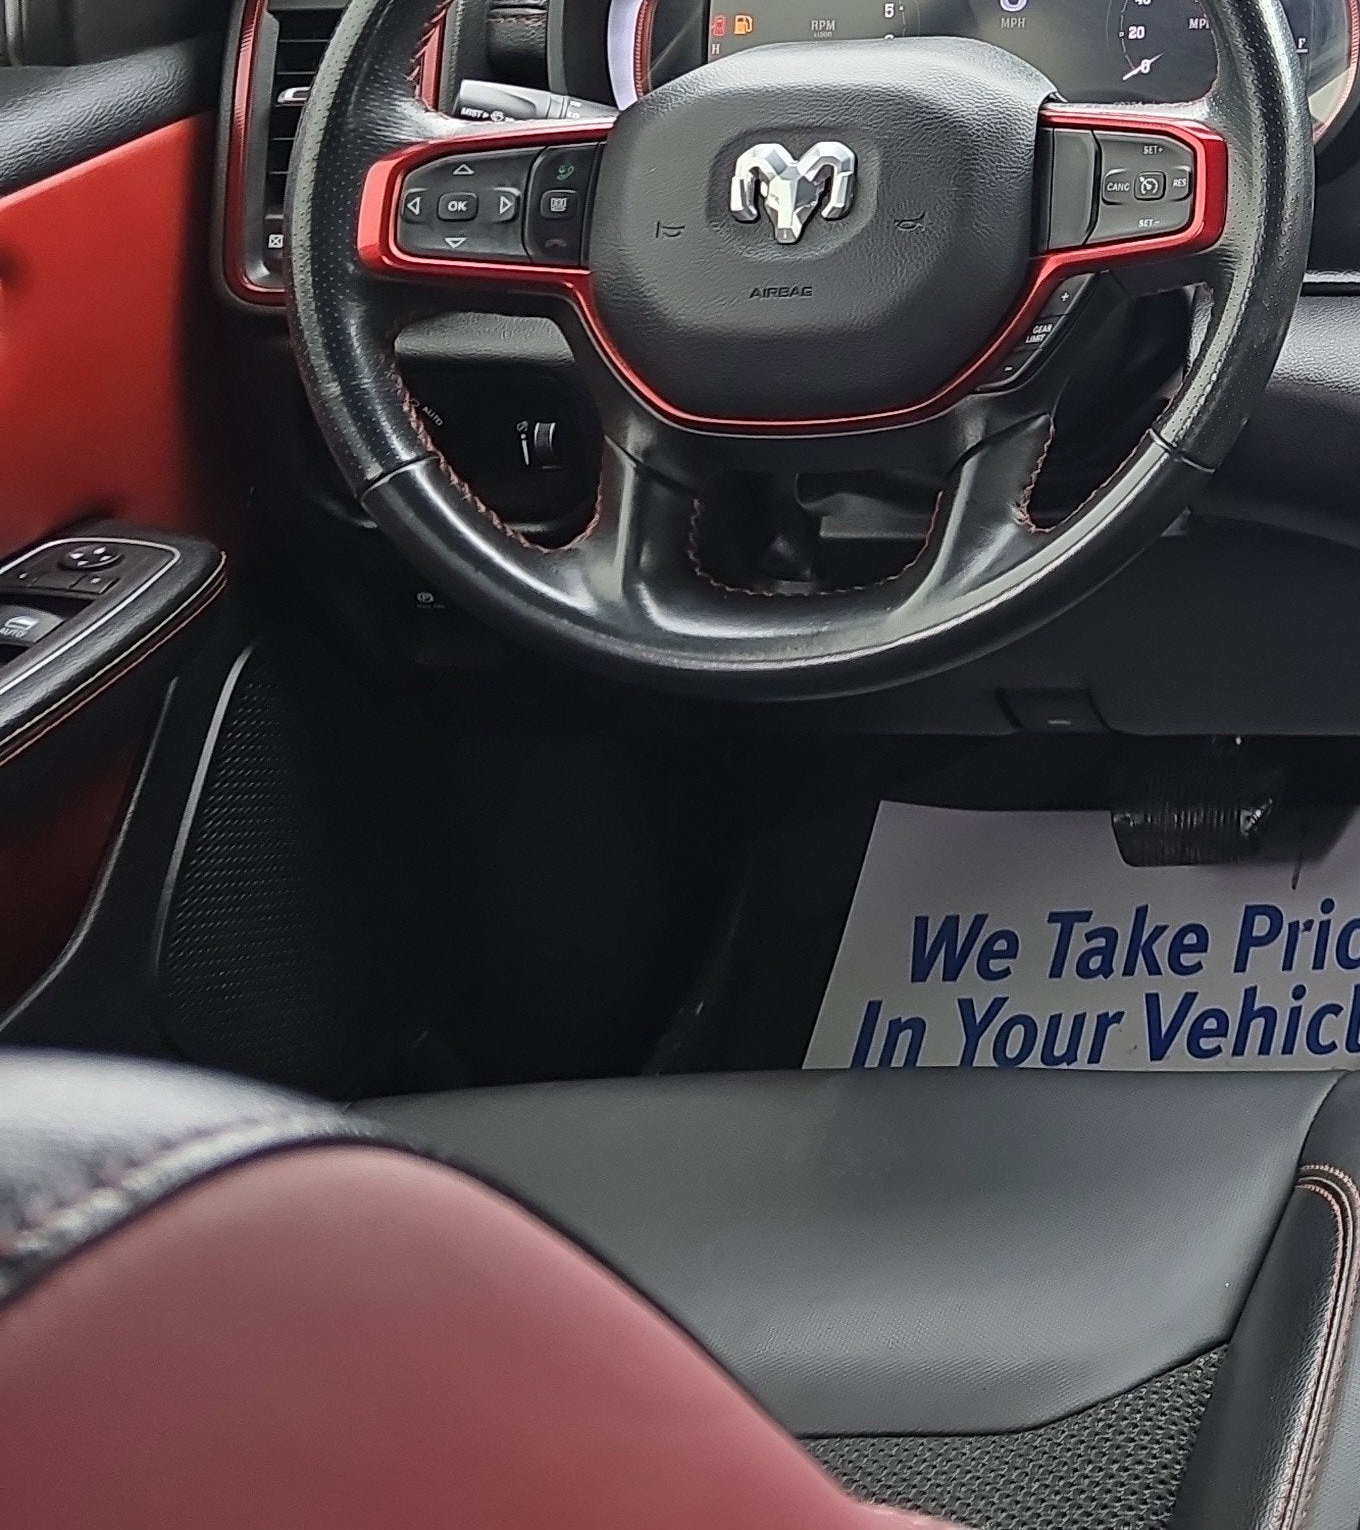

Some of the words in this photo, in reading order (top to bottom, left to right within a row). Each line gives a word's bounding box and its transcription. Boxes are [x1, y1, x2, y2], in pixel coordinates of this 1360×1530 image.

[884, 2, 894, 19] 5
[811, 20, 836, 31] RPM
[1001, 17, 1026, 29] MPH
[1128, 26, 1145, 39] 20
[711, 42, 721, 55] H
[1107, 182, 1130, 191] CANC
[1173, 178, 1187, 187] RES
[448, 200, 467, 212] OK
[748, 286, 813, 299] AIRBAG
[911, 911, 1021, 984] We
[1047, 903, 1210, 980] Take
[849, 999, 928, 1069] In
[955, 995, 1125, 1069] Your
